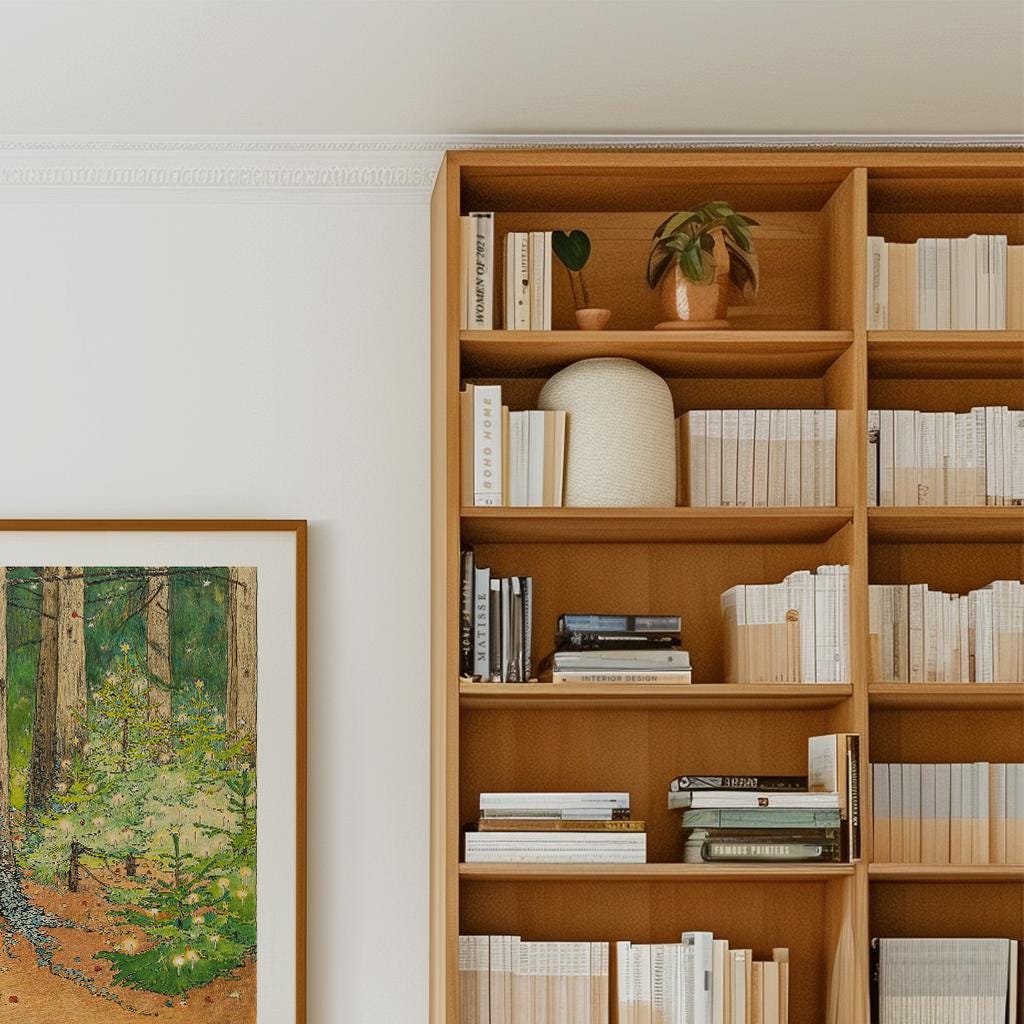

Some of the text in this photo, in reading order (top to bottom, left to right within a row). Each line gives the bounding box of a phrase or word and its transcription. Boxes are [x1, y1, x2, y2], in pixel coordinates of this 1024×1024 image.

[475, 259, 485, 275] OF
[475, 278, 485, 323] WOMEN
[483, 397, 492, 440] HOME
[483, 447, 492, 489] BOHO
[477, 593, 486, 661] MATISSE
[714, 845, 790, 855] FAMOUS PAINTERS
